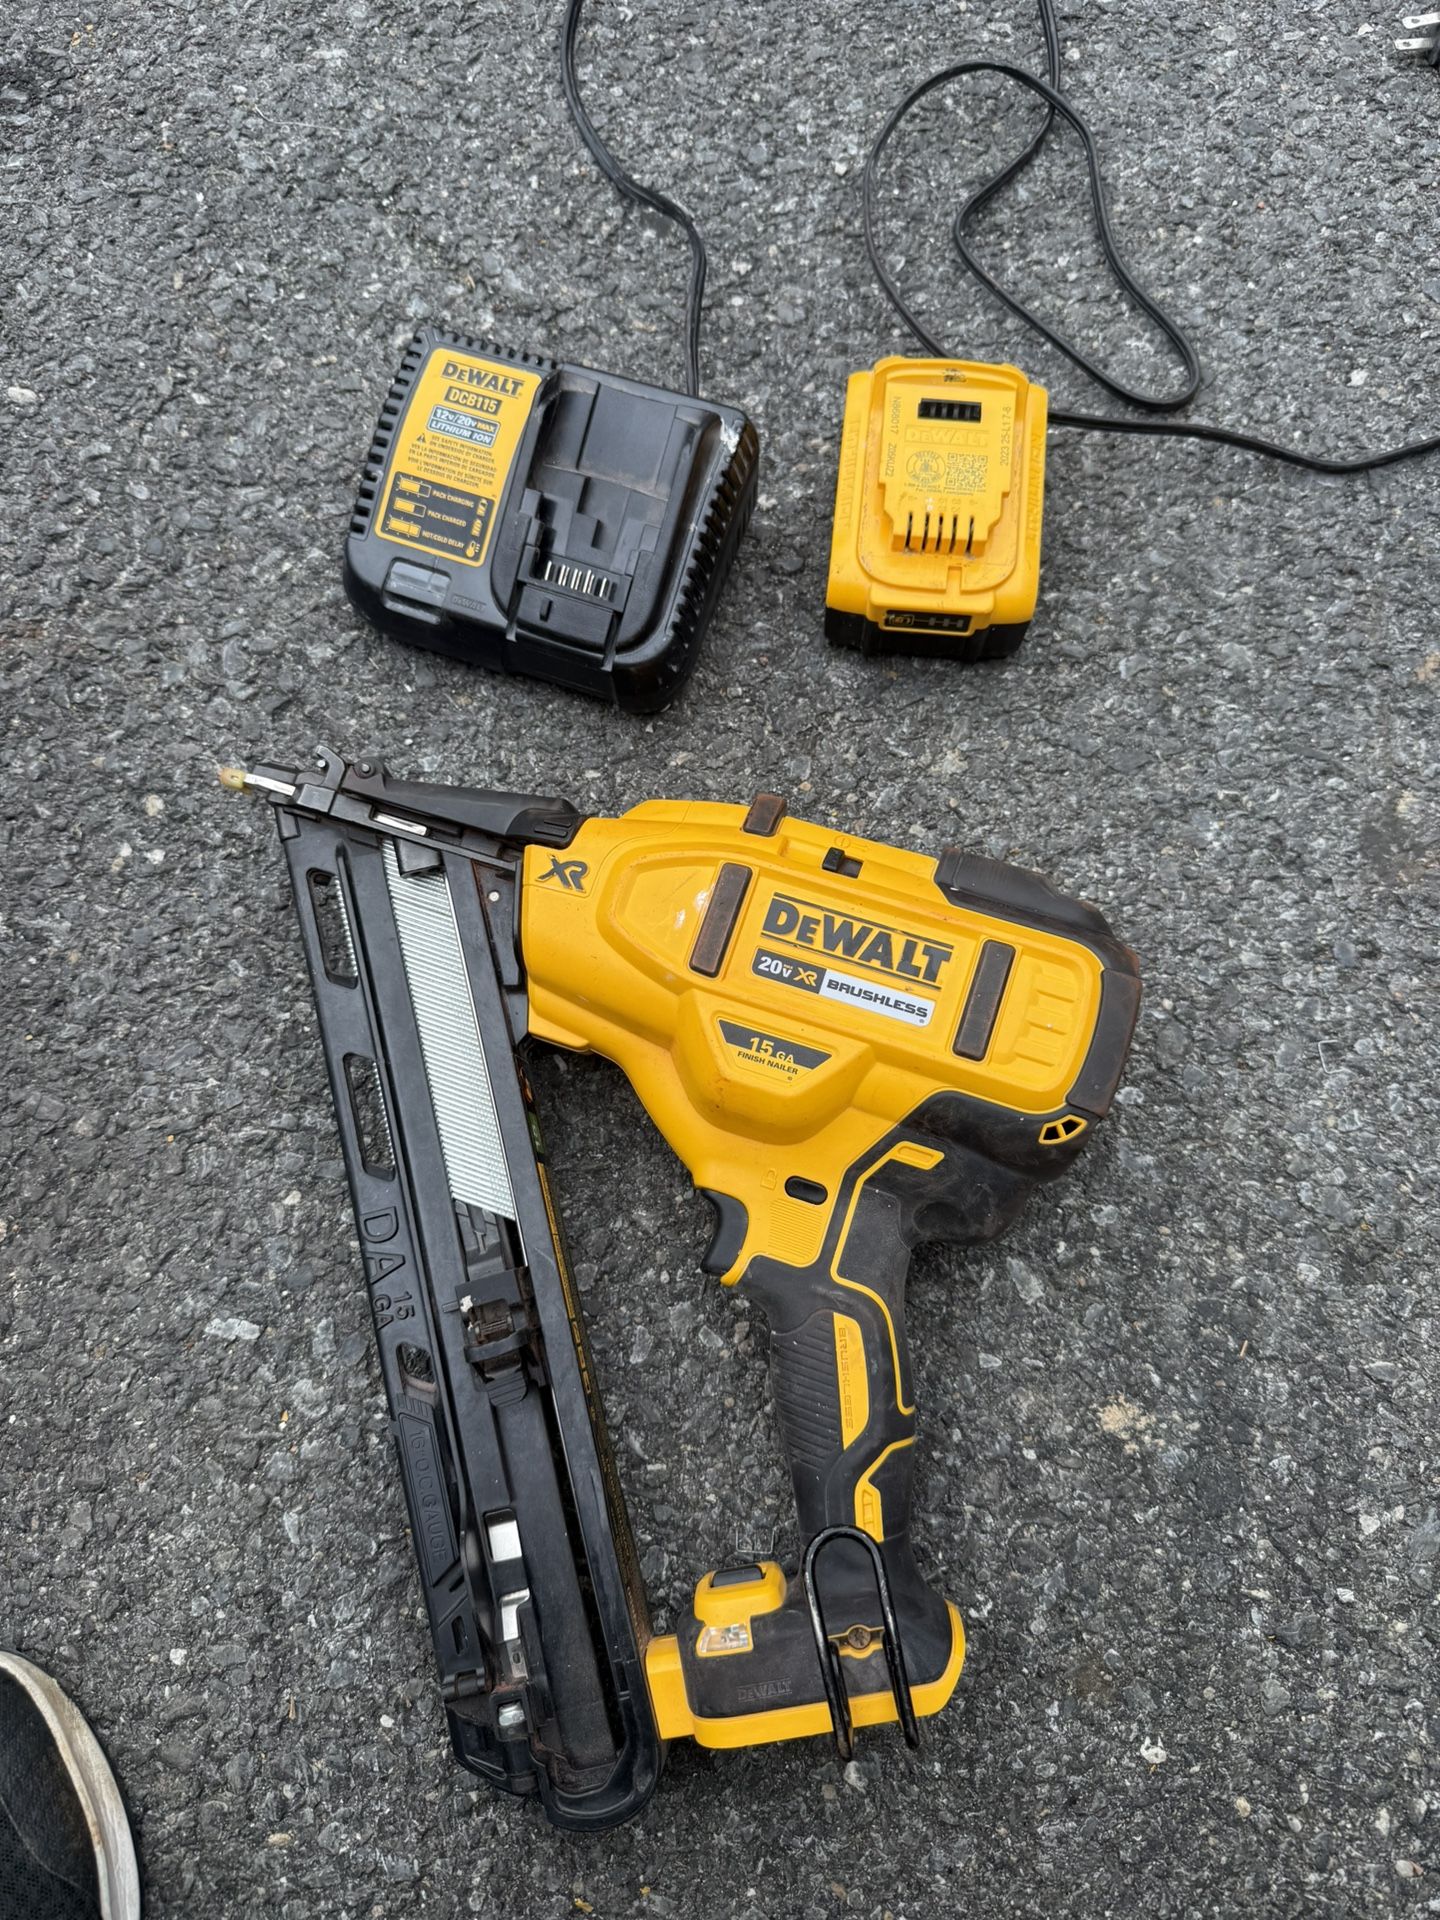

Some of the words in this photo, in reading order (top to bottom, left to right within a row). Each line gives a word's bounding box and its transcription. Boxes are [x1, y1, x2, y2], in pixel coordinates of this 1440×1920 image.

[442, 362, 523, 396] DEWALT
[448, 388, 497, 413] DCB115
[431, 420, 470, 437] LITHIUM
[472, 432, 491, 443] ION
[476, 422, 495, 432] MAX
[537, 853, 588, 893] XR
[763, 898, 952, 983] DEWALT
[793, 967, 818, 987] XR
[826, 979, 928, 1018] BRUSHLESS
[737, 1051, 766, 1065] FINISH
[767, 1058, 799, 1075] NAILER
[750, 1037, 775, 1057] 15
[776, 1051, 795, 1064] GA
[360, 1206, 406, 1285] DA
[394, 1291, 415, 1321] 15
[838, 1327, 853, 1430] BRUSHLESS
[421, 1493, 447, 1562] GAUGE
[738, 1681, 792, 1701] DEWALT
